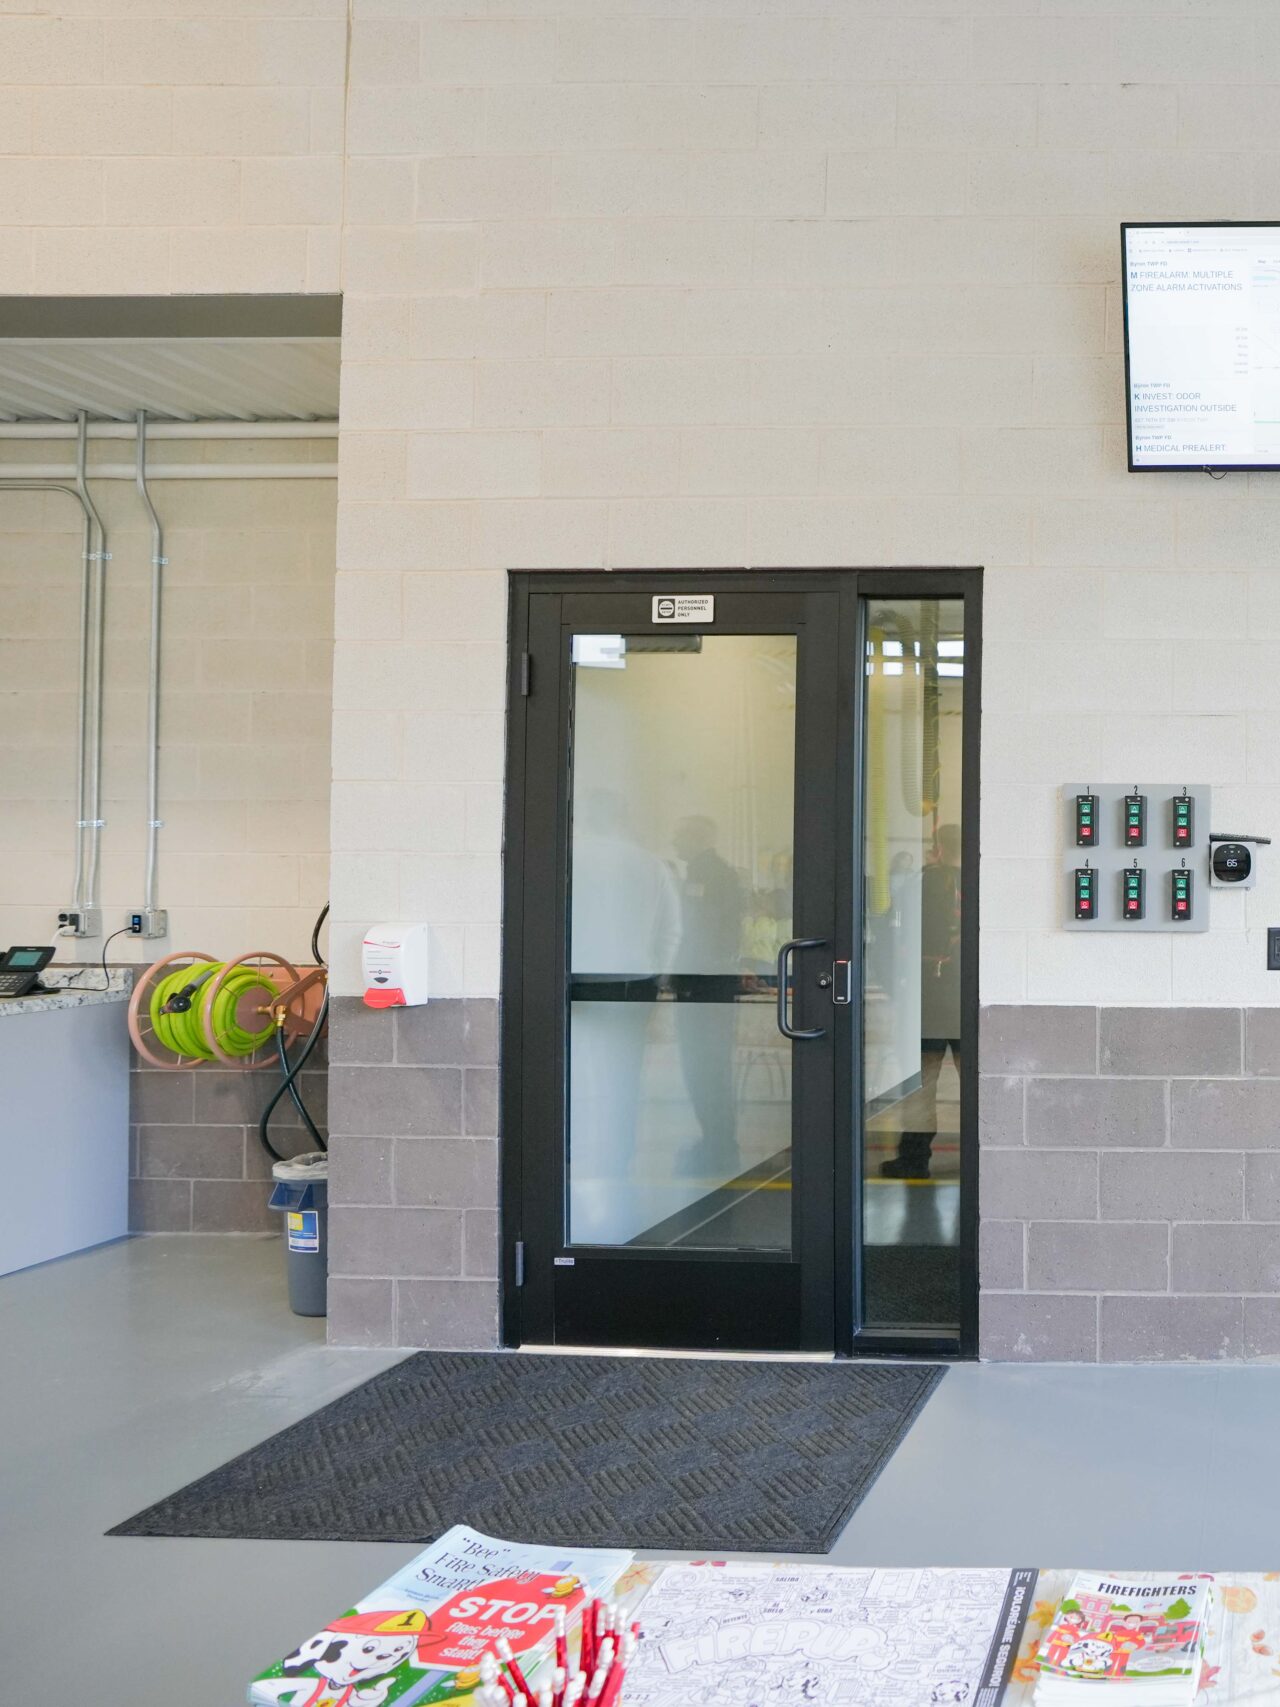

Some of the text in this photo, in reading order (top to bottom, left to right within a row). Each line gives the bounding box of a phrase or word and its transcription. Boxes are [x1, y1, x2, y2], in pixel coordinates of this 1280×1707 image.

[1130, 271, 1138, 279] M
[1192, 271, 1233, 279] MULTIPLE
[1131, 284, 1154, 292] ZONE
[1187, 283, 1242, 291] ACTIVATIONS
[1200, 404, 1237, 412] OUTSIDE
[1183, 444, 1225, 452] PREALERT
[1086, 785, 1090, 795] 1
[1133, 785, 1138, 795] 2
[1182, 786, 1187, 796] 3
[1084, 859, 1089, 868] 4
[1133, 858, 1138, 868] 5
[1181, 858, 1186, 868] 6
[1226, 859, 1238, 868] 65
[477, 1565, 541, 1584] Safety
[1097, 1582, 1198, 1598] FIREFIGHTERS
[449, 1596, 558, 1625] STOP
[397, 1611, 418, 1627] 1
